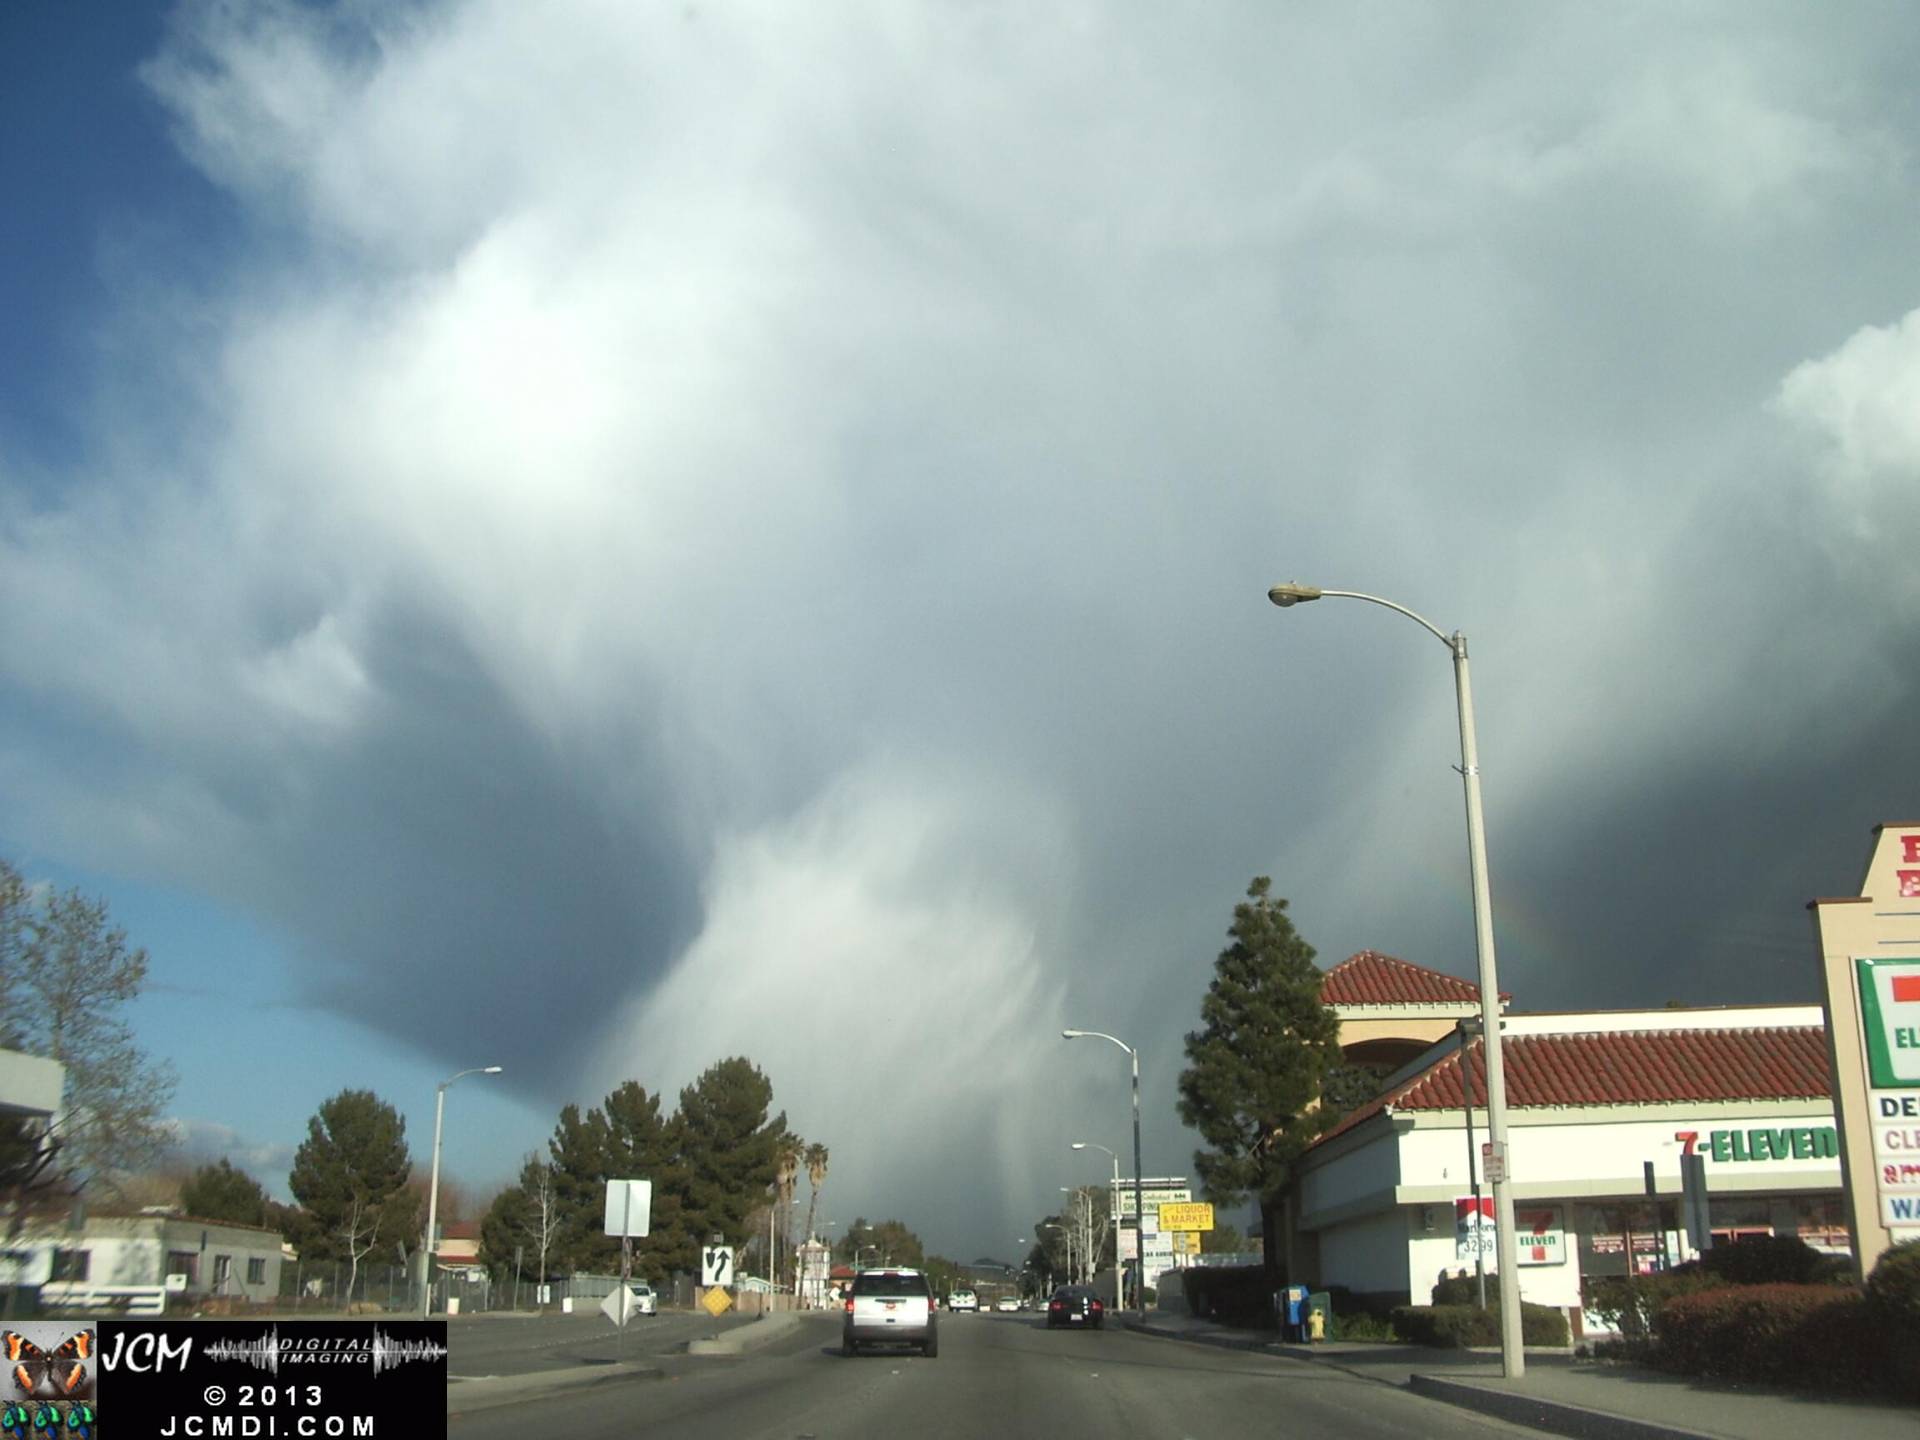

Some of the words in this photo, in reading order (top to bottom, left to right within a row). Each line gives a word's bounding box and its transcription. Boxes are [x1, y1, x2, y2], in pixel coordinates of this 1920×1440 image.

[1895, 1027, 1920, 1048] EL
[1880, 1097, 1920, 1117] DE
[1175, 1204, 1210, 1214] LIQUOR
[1170, 1214, 1210, 1224] MARKET
